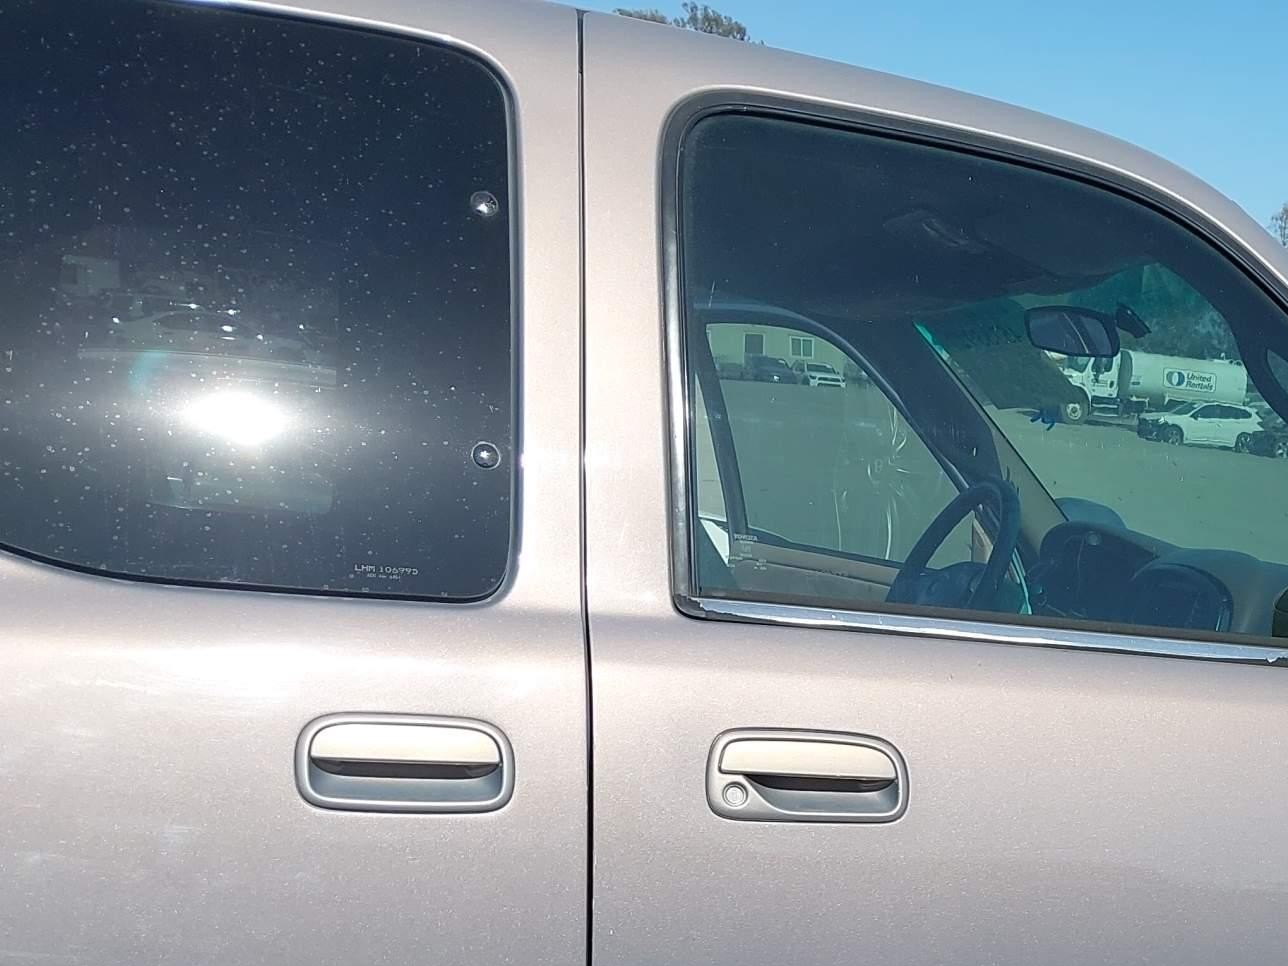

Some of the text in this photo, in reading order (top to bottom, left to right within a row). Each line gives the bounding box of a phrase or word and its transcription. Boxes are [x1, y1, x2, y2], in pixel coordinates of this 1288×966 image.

[1187, 373, 1212, 383] United
[1185, 381, 1214, 391] Rentals
[354, 564, 377, 573] LHM
